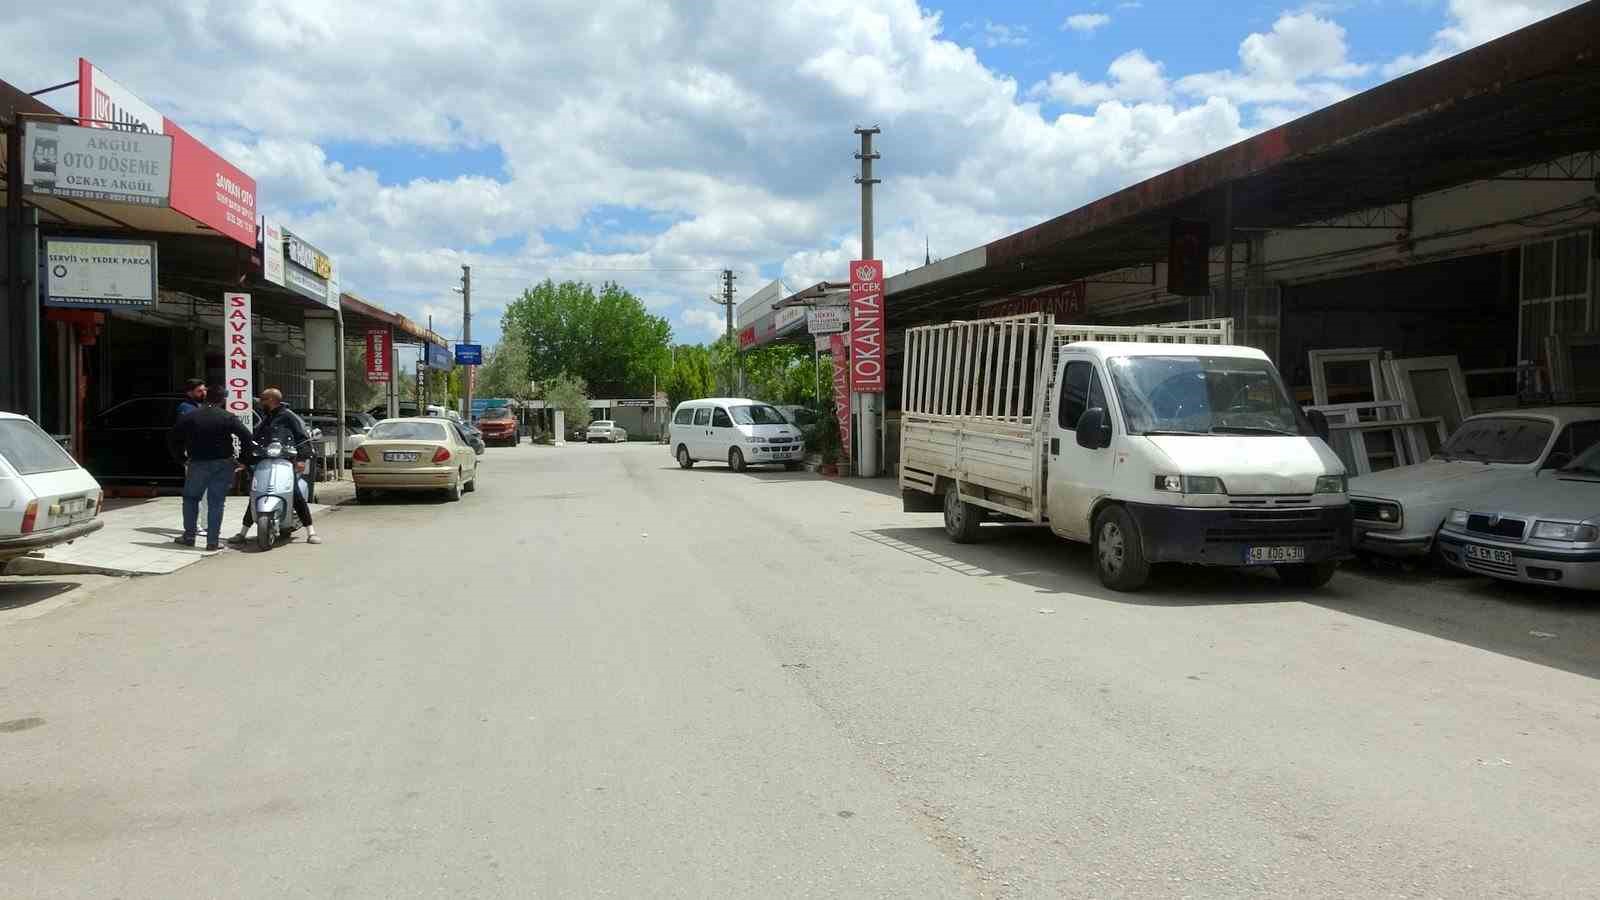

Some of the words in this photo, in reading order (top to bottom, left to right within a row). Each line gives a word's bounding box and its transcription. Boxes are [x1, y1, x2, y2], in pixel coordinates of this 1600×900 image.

[64, 152, 94, 169] OTO
[99, 152, 160, 177] DÖŞEME
[241, 190, 254, 207] OTO
[230, 297, 247, 369] SAVRAN
[854, 294, 880, 384] LOKANTA
[229, 378, 248, 410] OTO
[1251, 547, 1262, 560] 48
